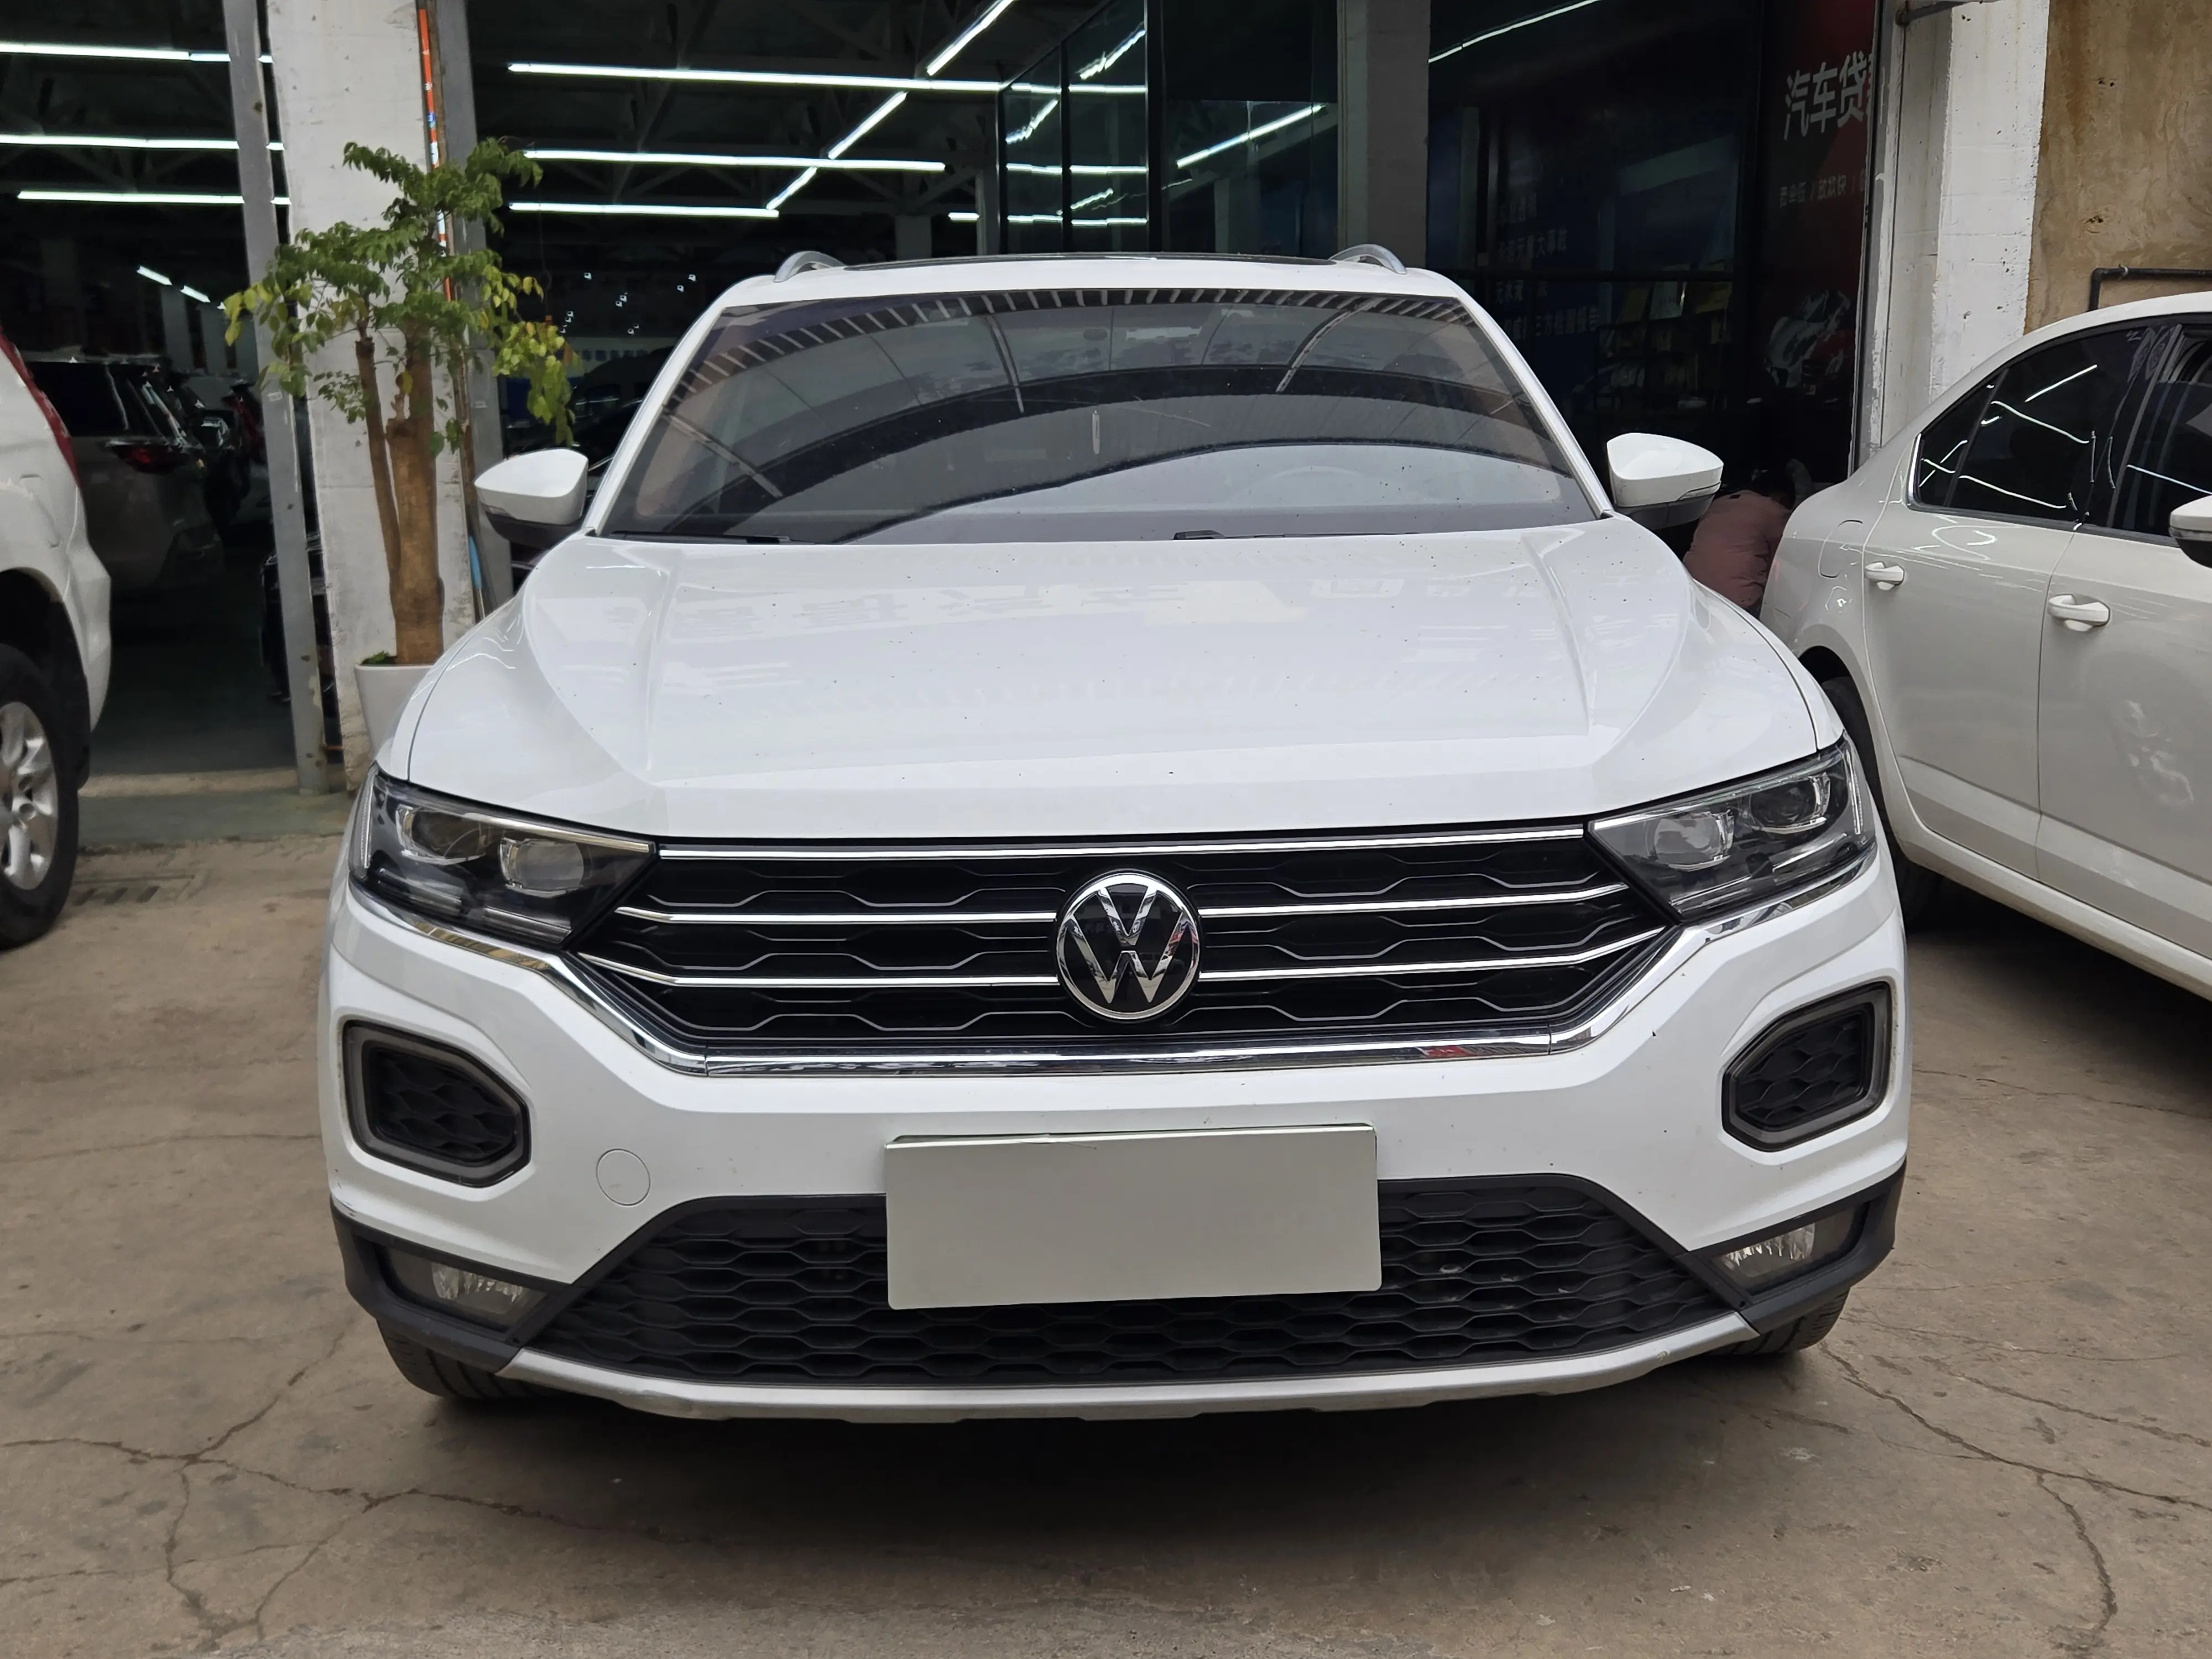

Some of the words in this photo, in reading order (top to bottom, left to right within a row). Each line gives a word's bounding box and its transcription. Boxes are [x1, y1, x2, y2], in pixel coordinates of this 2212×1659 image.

[1783, 50, 1874, 141] 汽车贷
[1059, 878, 1197, 1008] VW
